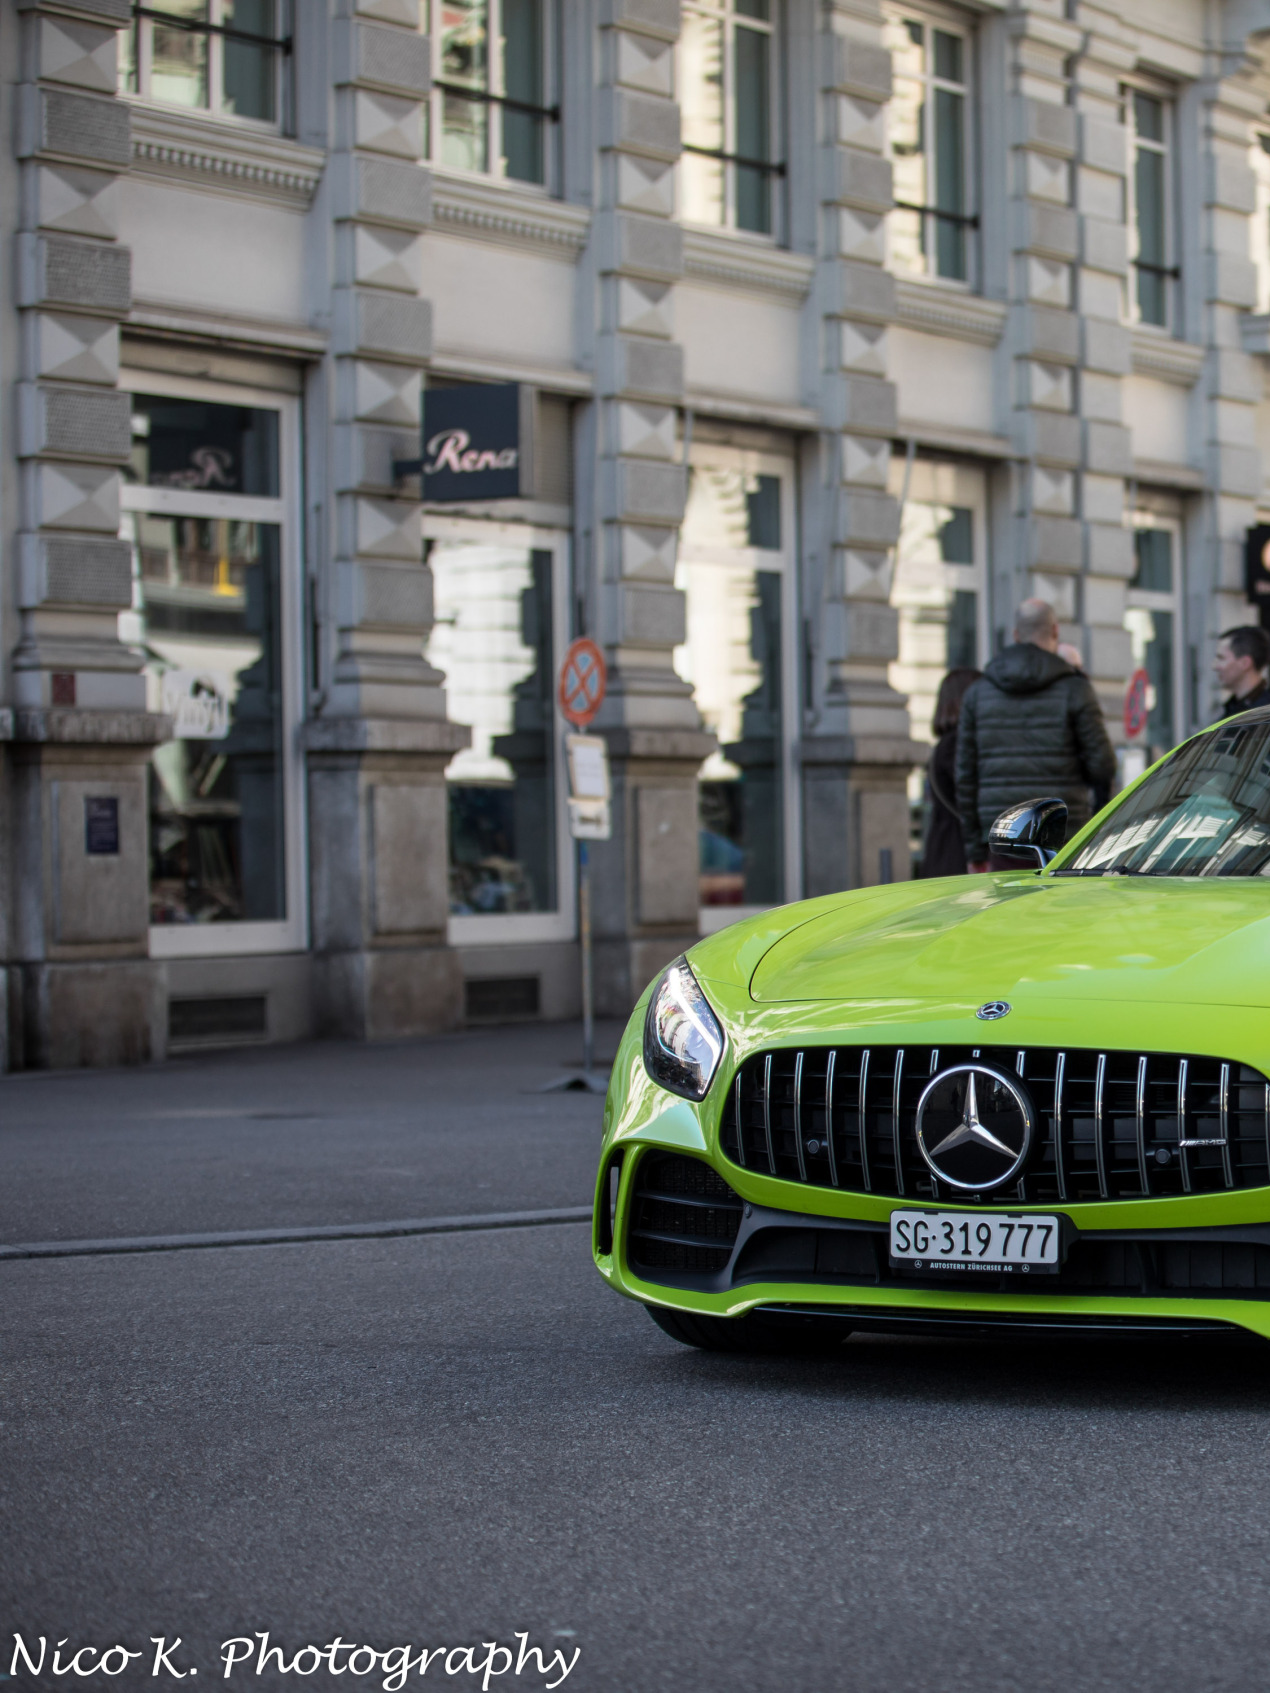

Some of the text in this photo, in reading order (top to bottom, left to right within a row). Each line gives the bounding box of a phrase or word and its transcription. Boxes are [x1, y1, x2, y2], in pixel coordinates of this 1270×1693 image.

[424, 428, 518, 474] Rena
[929, 1261, 966, 1270] AUTOSTERN
[967, 1262, 1002, 1272] ZÜRICHSEE
